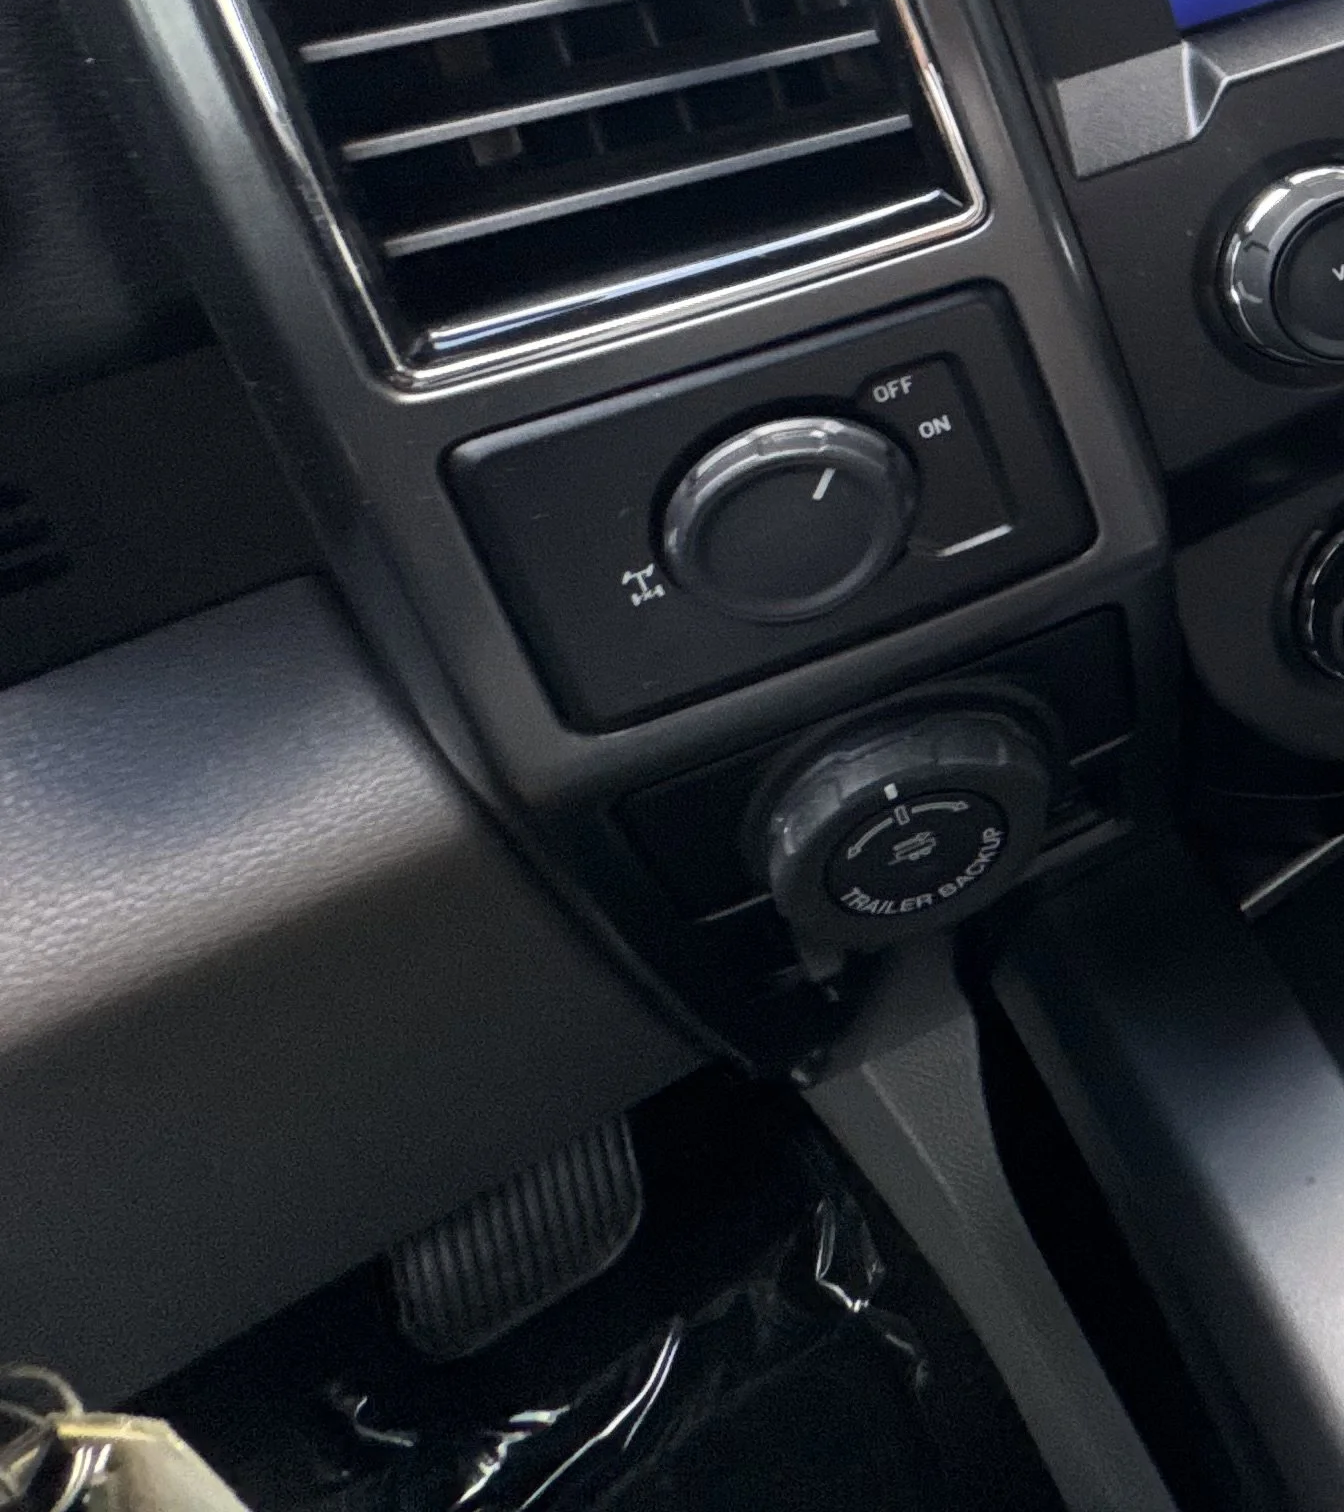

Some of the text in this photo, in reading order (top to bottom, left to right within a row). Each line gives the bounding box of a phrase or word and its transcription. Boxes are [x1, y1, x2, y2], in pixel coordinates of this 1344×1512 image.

[873, 376, 913, 403] OFF
[917, 413, 952, 440] ON
[840, 826, 1006, 915] TRAILER BACKUP
